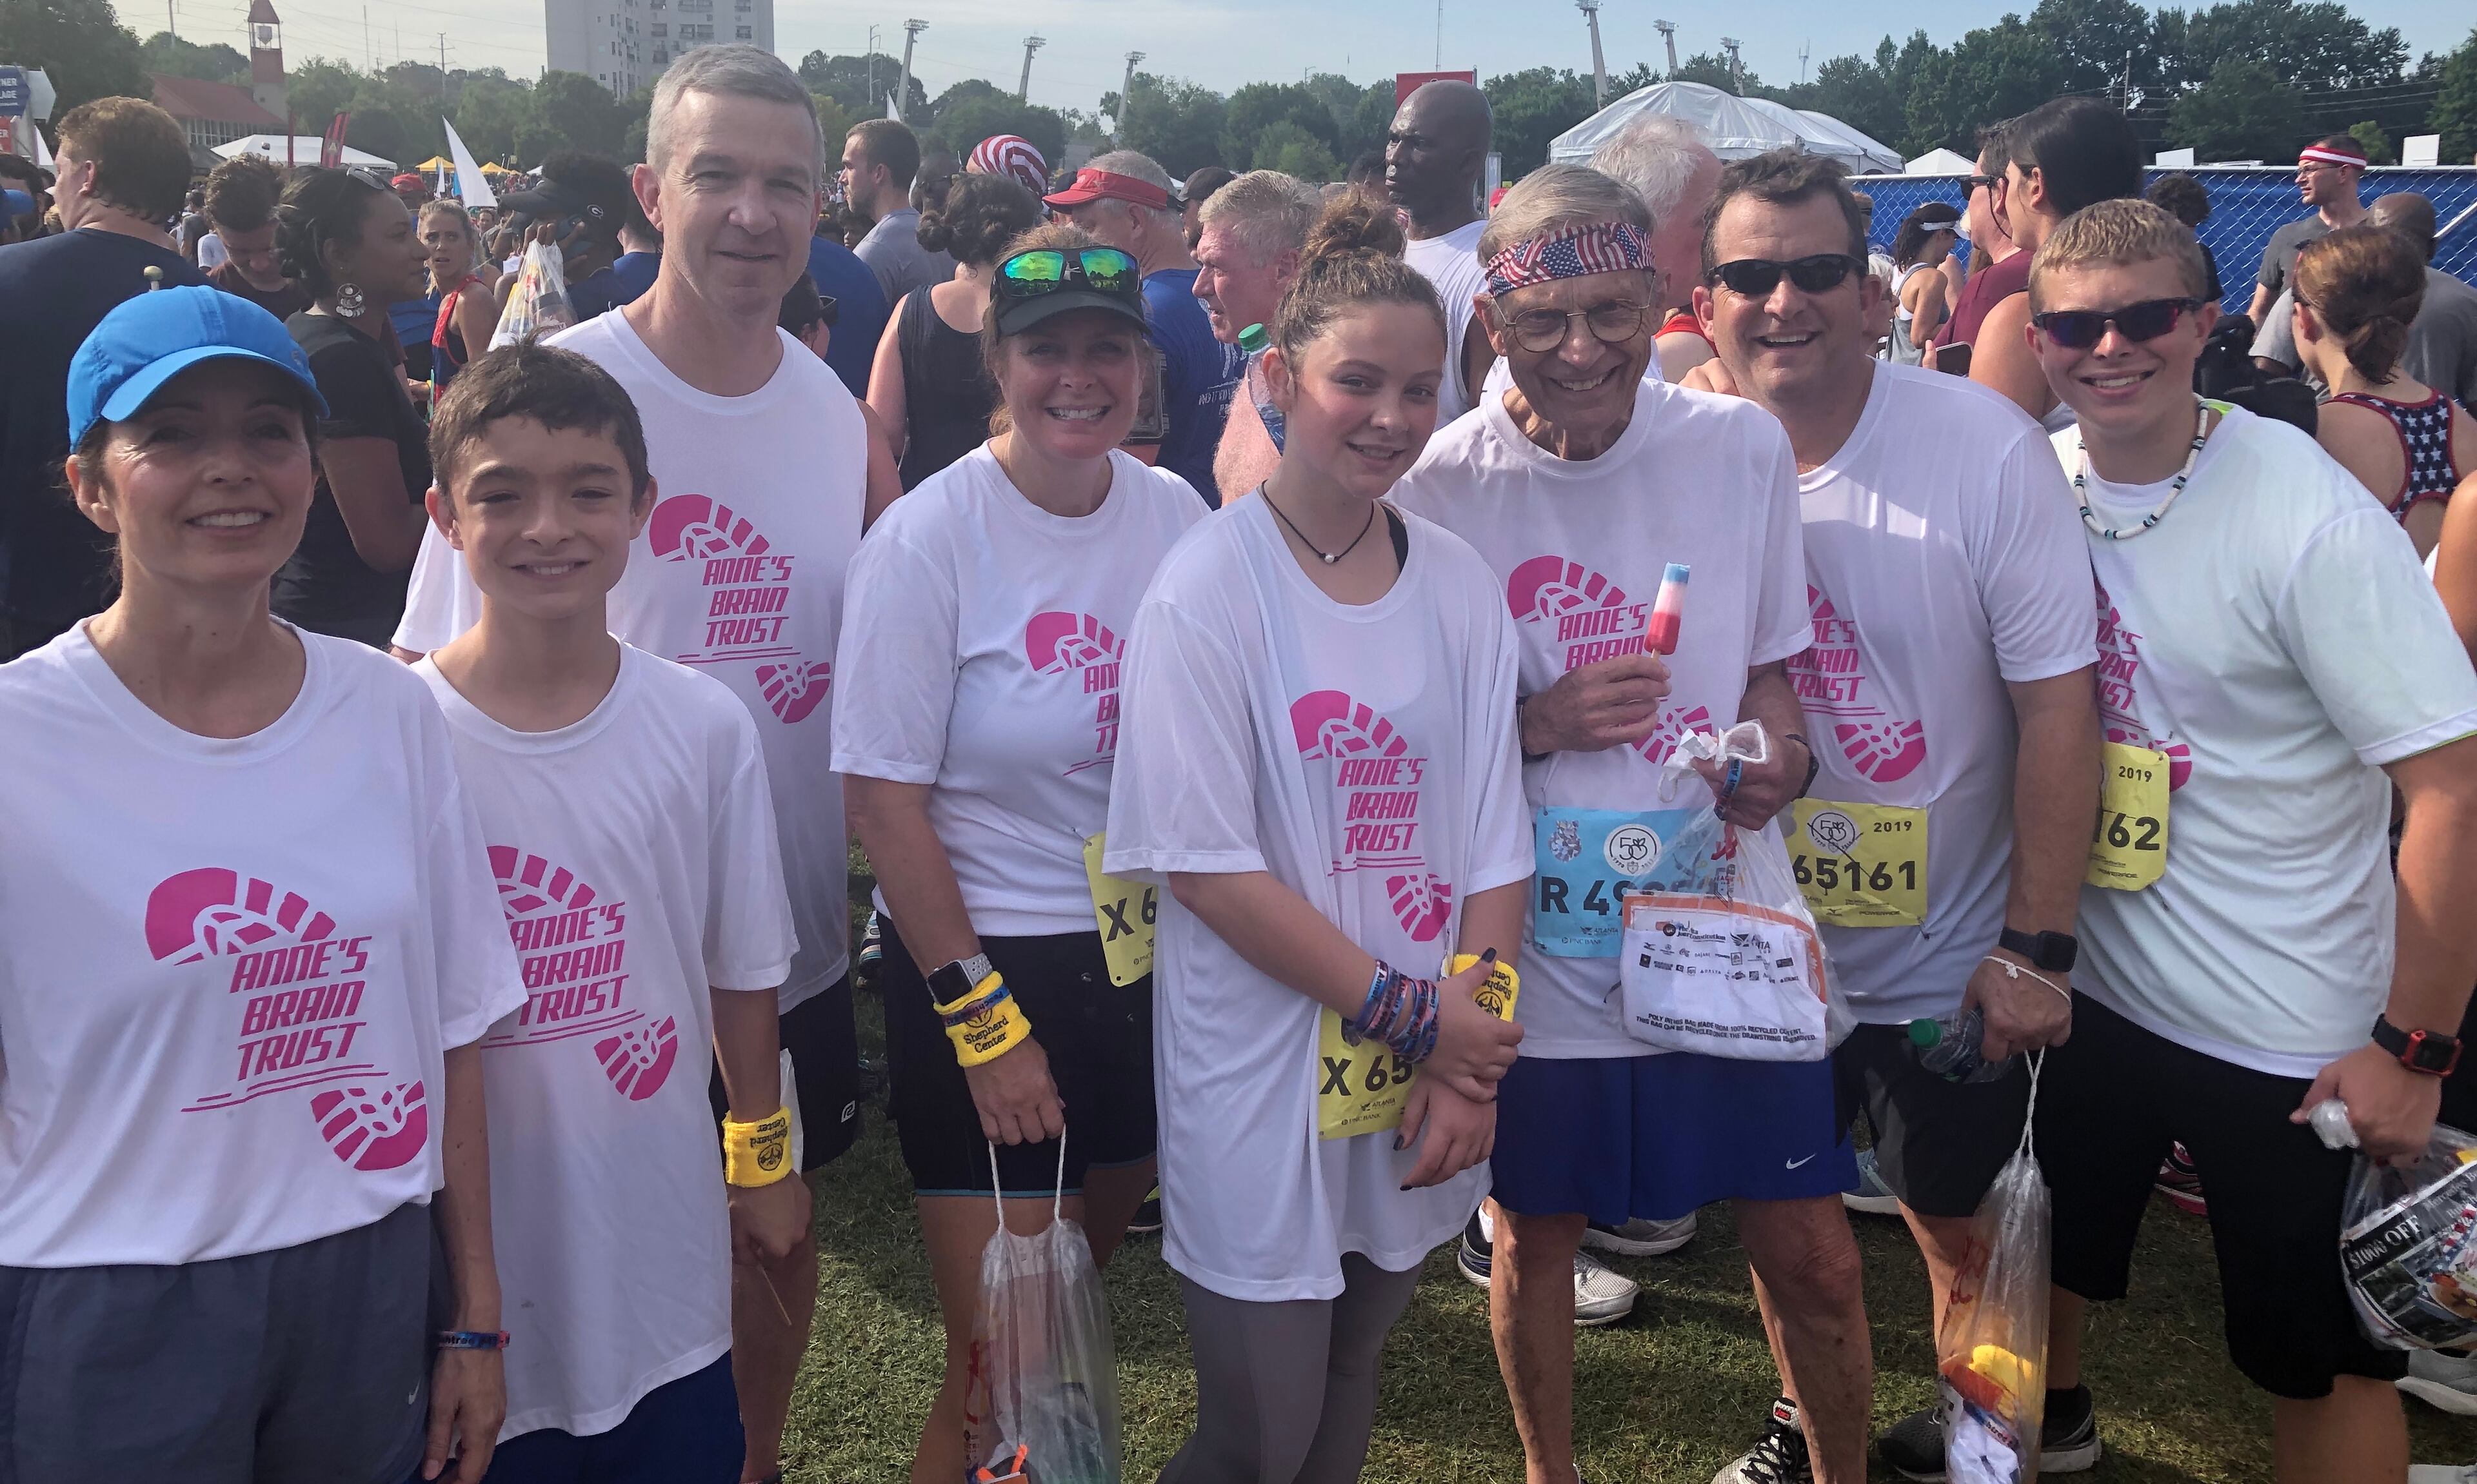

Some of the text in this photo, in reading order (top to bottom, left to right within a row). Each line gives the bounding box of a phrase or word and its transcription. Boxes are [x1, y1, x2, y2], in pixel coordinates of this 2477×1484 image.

[0, 78, 17, 86] NER
[702, 555, 795, 586] ANNE'S
[708, 587, 790, 617] BRAIN
[704, 616, 790, 647] TRUST
[1557, 603, 1648, 642] ANNE'S
[1337, 758, 1428, 787] ANNE'S
[2118, 766, 2153, 782] 2019
[1346, 791, 1419, 821] BRAIN
[1344, 823, 1419, 855] TRUST
[1873, 820, 1913, 833] 2019
[2093, 807, 2160, 851] 162
[1792, 855, 1916, 892] 65161
[1541, 876, 1570, 914] R
[510, 902, 626, 951] ANNE'S
[1099, 887, 1157, 942] X 6
[229, 936, 372, 994] ANNE'S
[521, 940, 625, 989] BRAIN
[240, 980, 366, 1037] BRAIN
[519, 974, 630, 1026] TRUST
[963, 1016, 1009, 1044] Shepherd
[974, 1033, 1007, 1053] Center
[1747, 1025, 1778, 1034] RECYCLED
[237, 1022, 367, 1082] TRUST
[1318, 1054, 1413, 1096] X 65
[2348, 1215, 2421, 1270] $1000 OFF
